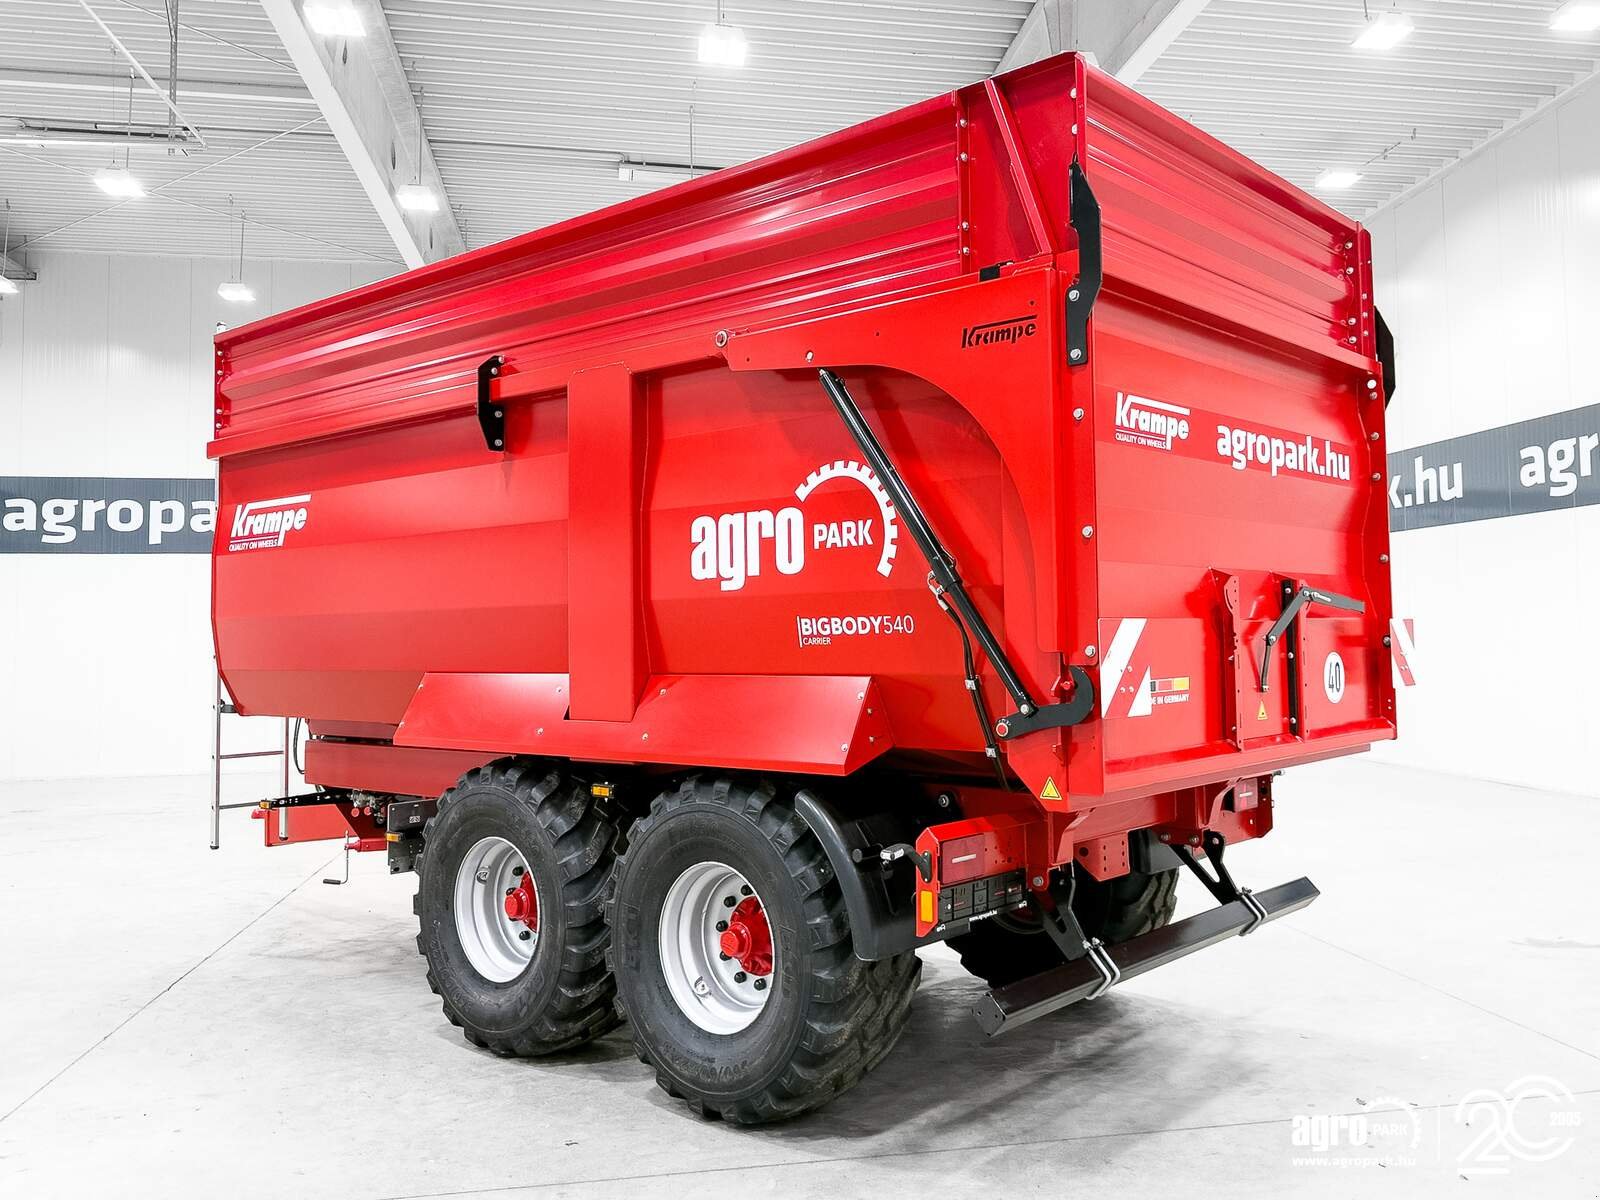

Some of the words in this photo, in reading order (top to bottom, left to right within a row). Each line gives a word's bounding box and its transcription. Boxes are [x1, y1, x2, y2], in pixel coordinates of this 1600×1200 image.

[961, 315, 1038, 348] Krampe
[1115, 391, 1191, 451] Krampe
[1115, 432, 1138, 443] QUALITY
[1137, 437, 1147, 446] ON
[1146, 439, 1166, 449] WHEELS
[1216, 424, 1350, 481] agropark.hu
[1519, 432, 1600, 498] agr
[231, 493, 312, 547] Krampe
[228, 542, 249, 552] QUALITY
[249, 541, 258, 550] ON
[257, 539, 278, 549] WHEELS
[690, 506, 805, 592] agro
[813, 518, 874, 550] PARK
[802, 636, 832, 646] CARRIER
[1328, 661, 1341, 693] 40
